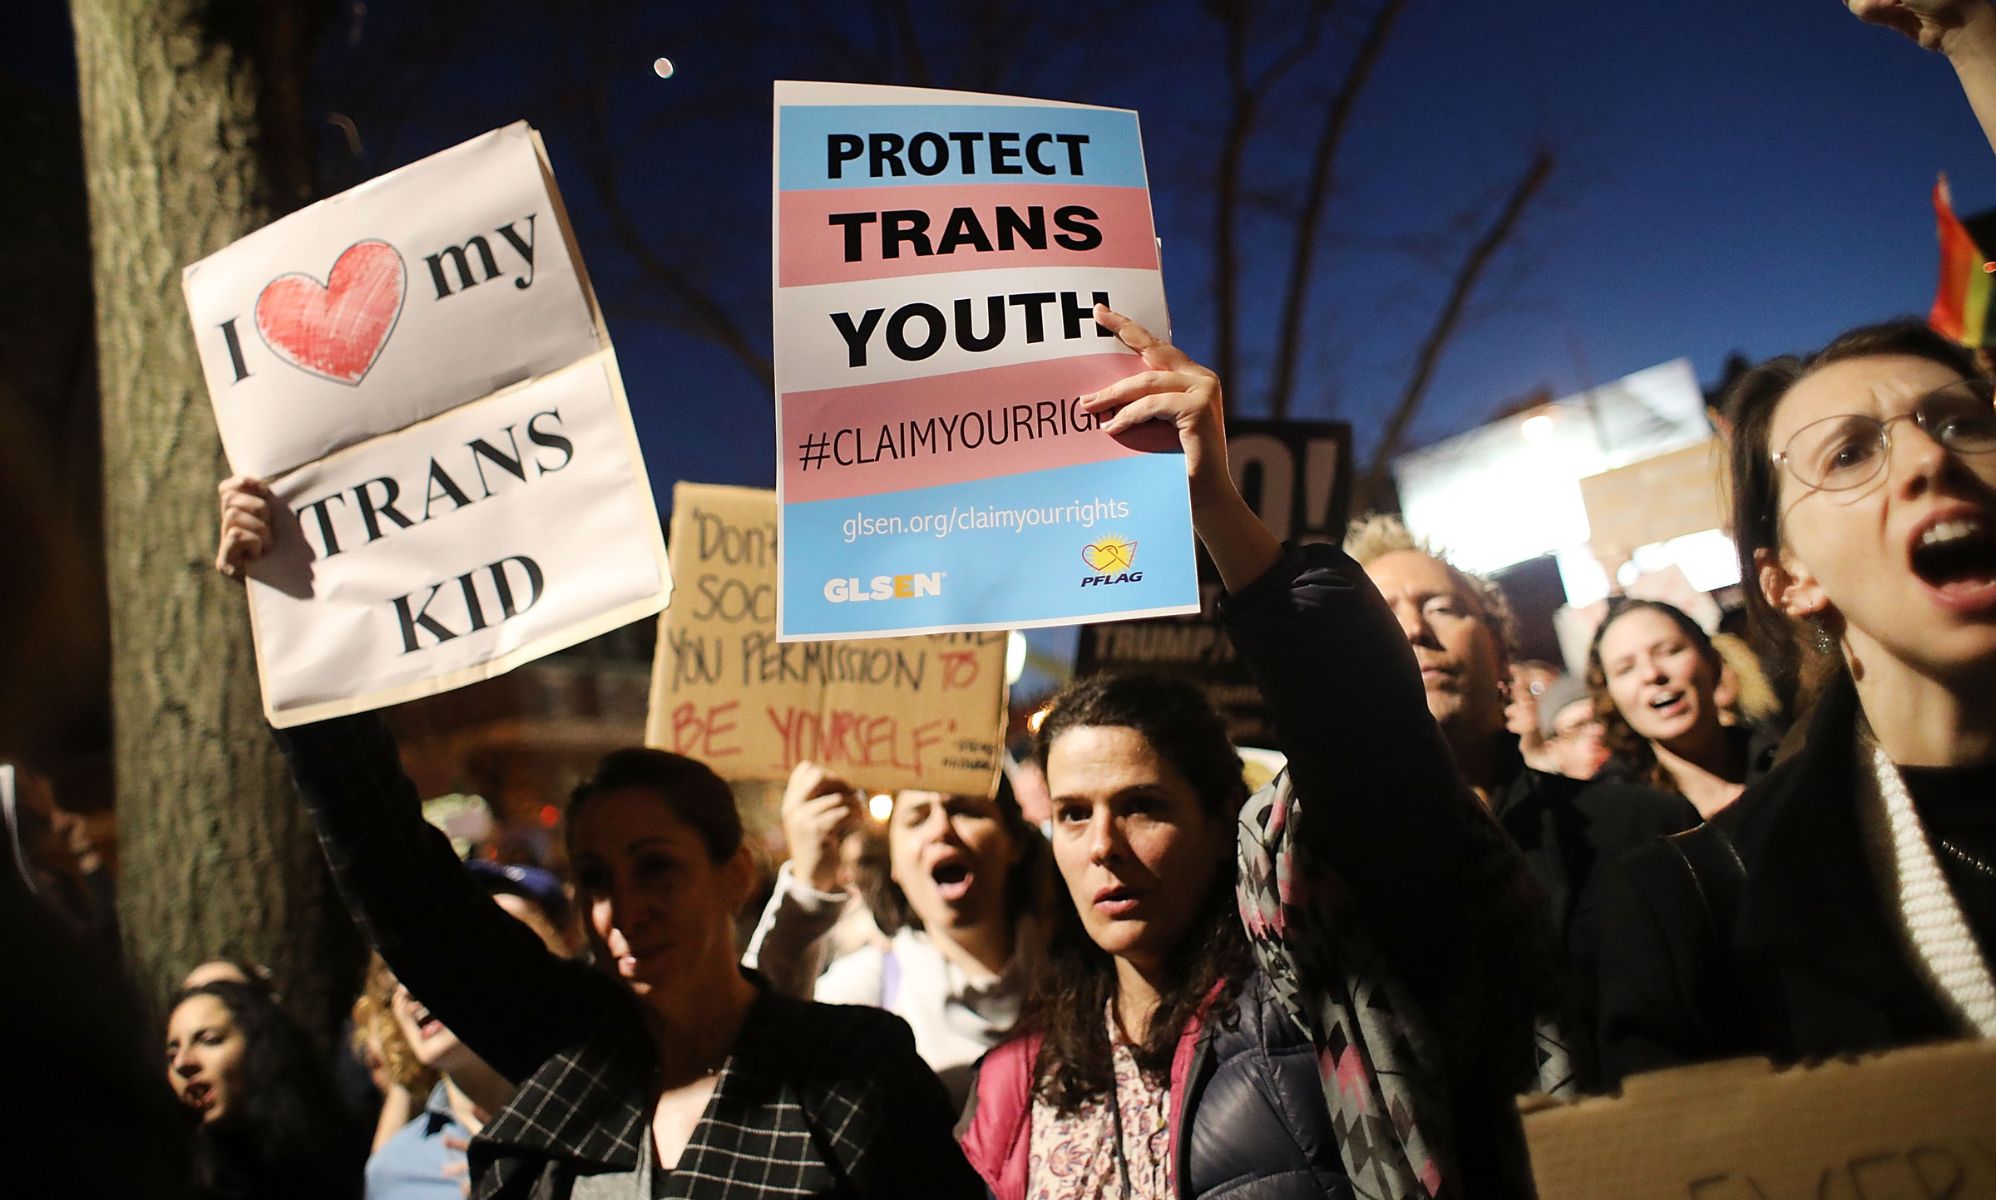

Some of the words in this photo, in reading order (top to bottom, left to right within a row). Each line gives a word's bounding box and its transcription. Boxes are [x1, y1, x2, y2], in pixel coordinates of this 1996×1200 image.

[827, 131, 1090, 179] PROTECT
[828, 205, 1103, 263] TRANS
[217, 316, 254, 387] I
[422, 212, 539, 302] my
[829, 291, 1114, 368] YOUTH
[297, 408, 575, 560] TRANS
[842, 497, 1130, 543] glsen.org/claimyourrights
[392, 554, 546, 658] KID
[1080, 571, 1144, 588] PFLAG
[668, 627, 722, 692] YOU
[741, 630, 926, 691] PERMISSION
[938, 650, 980, 691] TO
[671, 700, 742, 757] BE
